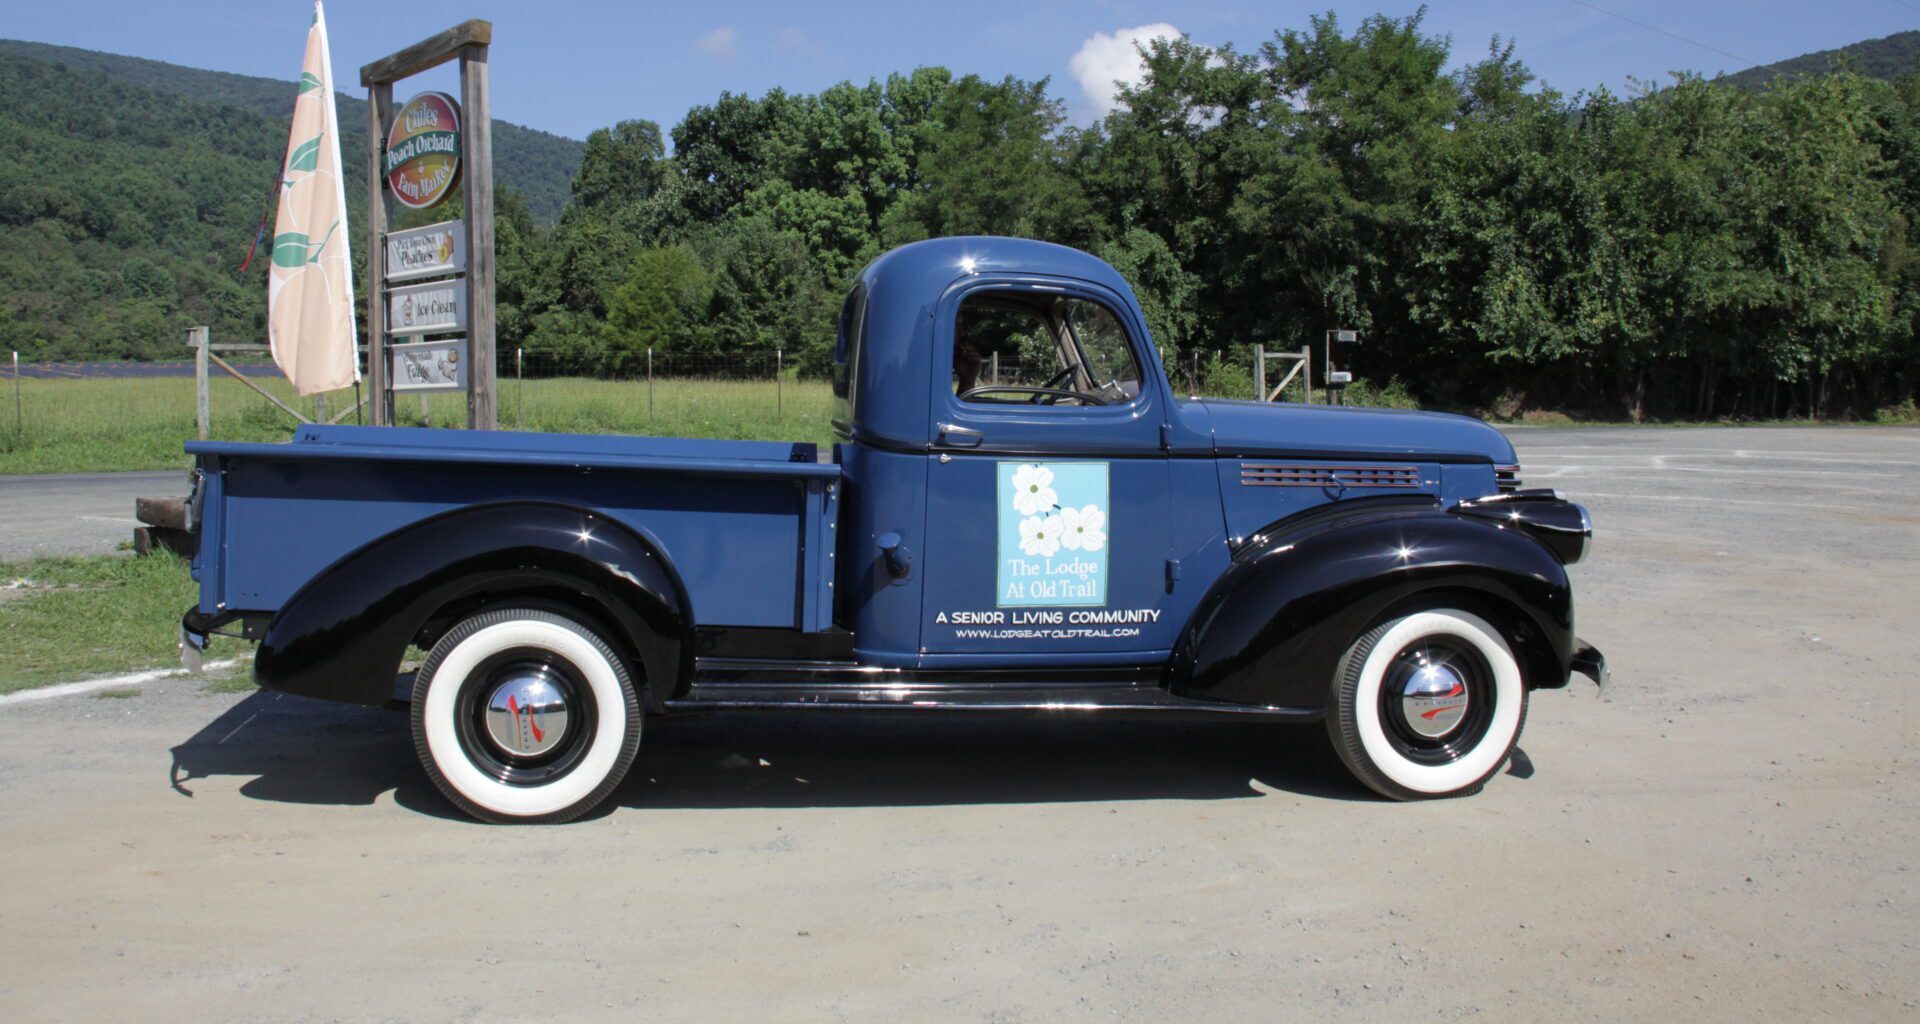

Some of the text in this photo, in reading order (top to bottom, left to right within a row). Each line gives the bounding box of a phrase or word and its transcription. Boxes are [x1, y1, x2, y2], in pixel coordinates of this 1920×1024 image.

[406, 103, 437, 133] Chiles
[388, 134, 454, 170] Peach Orchard
[398, 159, 450, 199] Farm Market
[401, 250, 433, 266] Peaches
[418, 300, 457, 316] Ice Cream
[1008, 558, 1098, 580] The Lodge
[1006, 580, 1097, 599] At Old Trail
[935, 610, 1161, 624] A SENIOR LIVING COMMUNITY
[956, 628, 1140, 639] WWW.LODGEATOLDTRAIL.COM
